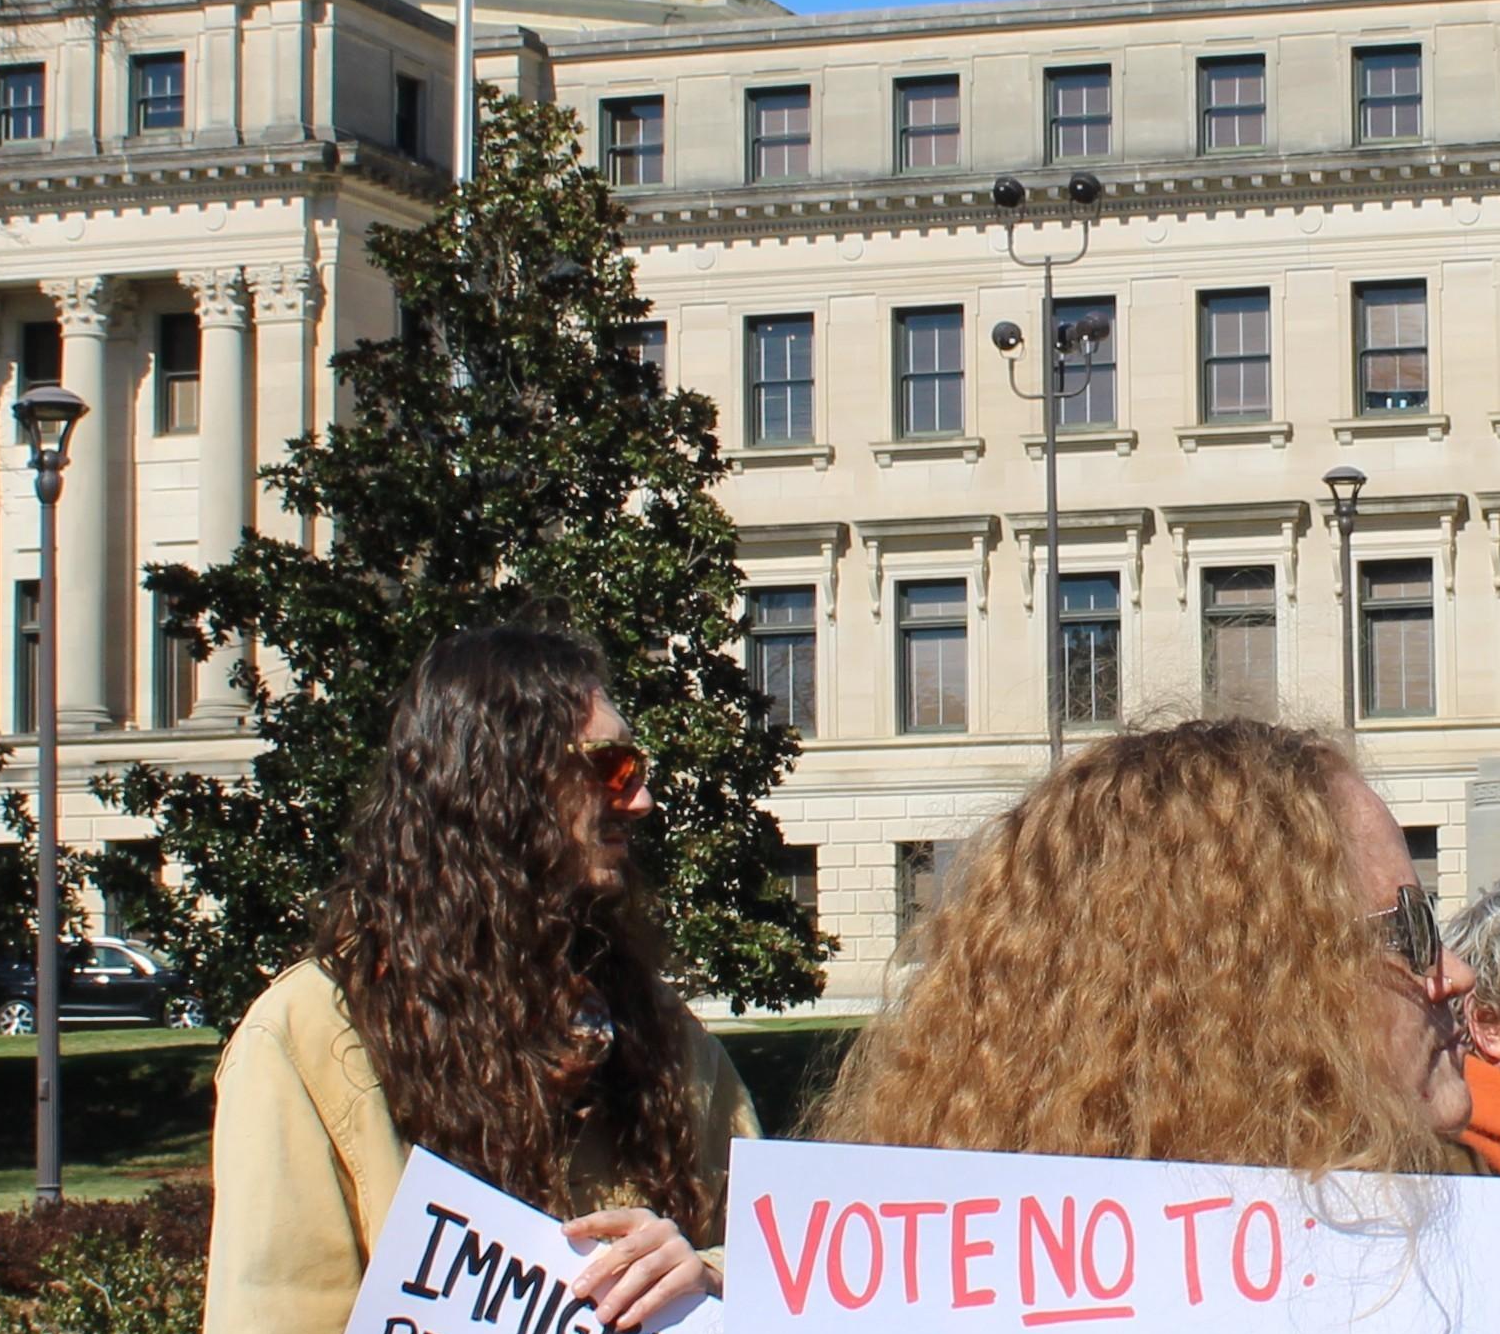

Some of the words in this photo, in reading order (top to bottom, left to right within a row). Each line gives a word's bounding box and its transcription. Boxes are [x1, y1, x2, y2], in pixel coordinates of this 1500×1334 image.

[753, 1195, 1000, 1315] VOTE
[1020, 1197, 1136, 1317] NO
[1164, 1196, 1318, 1303] TO:
